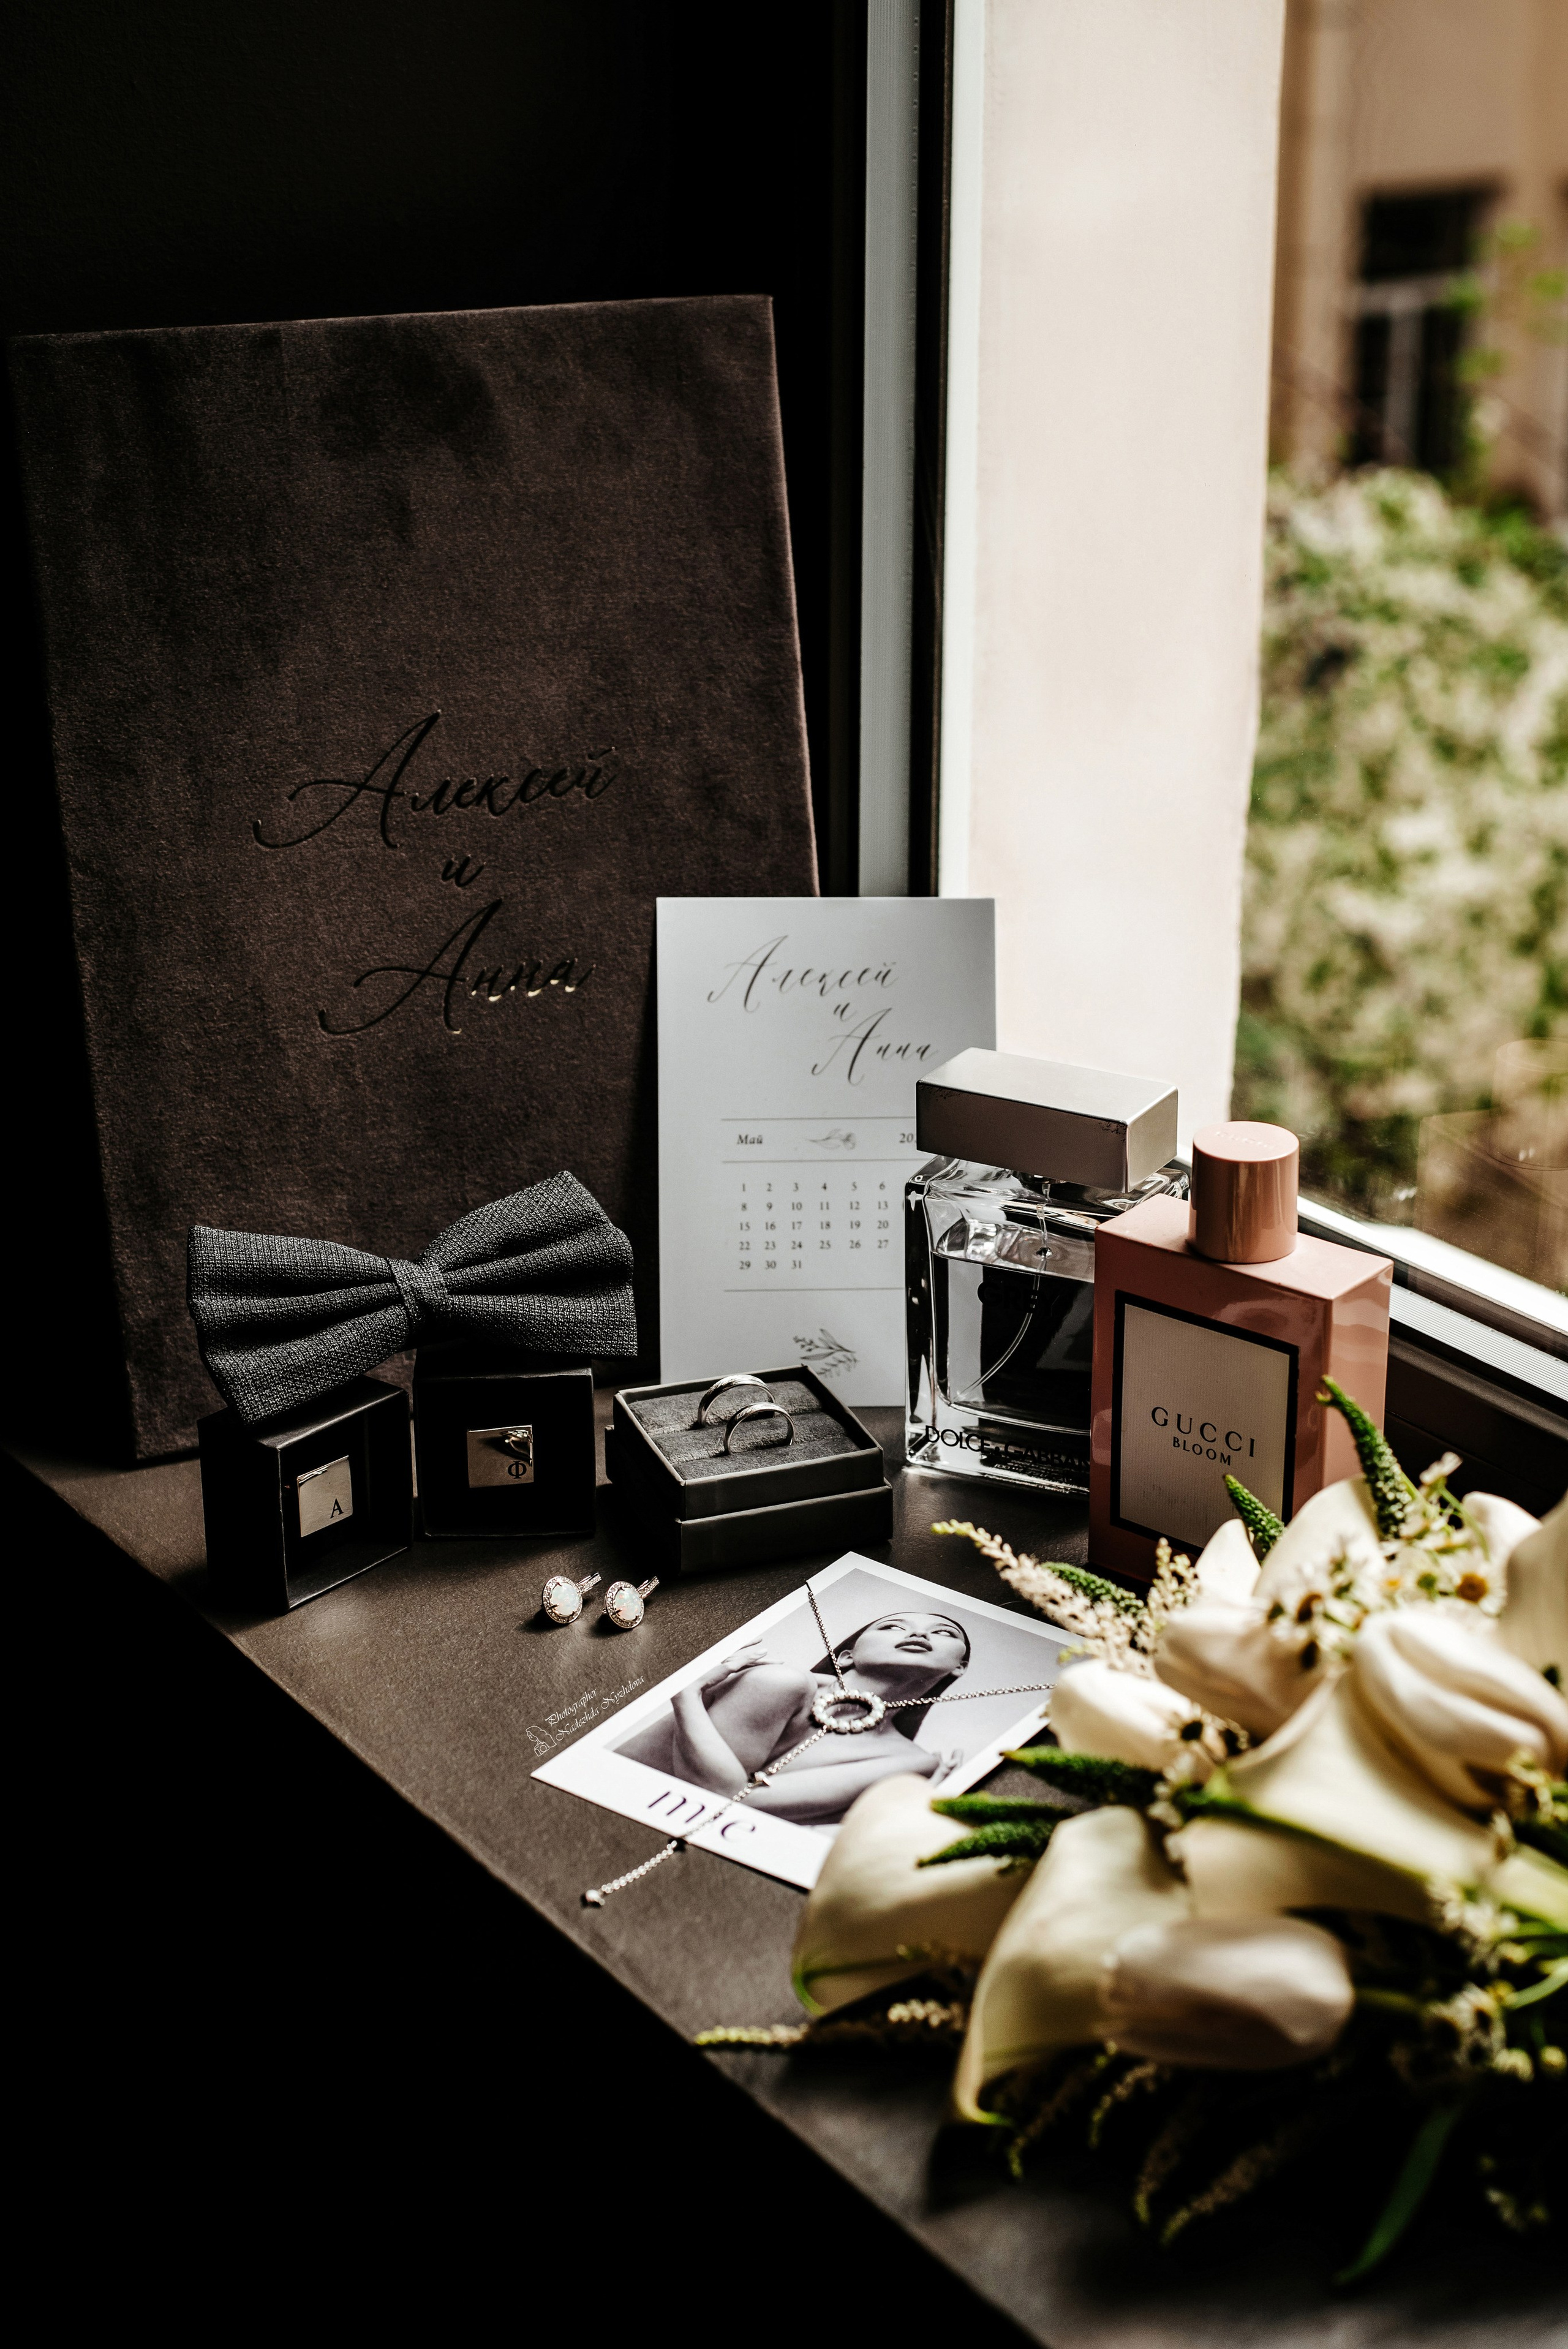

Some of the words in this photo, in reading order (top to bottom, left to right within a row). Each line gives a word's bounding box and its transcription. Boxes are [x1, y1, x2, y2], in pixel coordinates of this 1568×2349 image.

[253, 709, 616, 850] Алексей
[441, 855, 486, 888] и
[317, 898, 596, 1035] Анна
[707, 935, 899, 1013] Алексей
[833, 1002, 858, 1022] и
[811, 1008, 939, 1085] Анна
[736, 1133, 763, 1145] Май
[899, 1133, 916, 1144] 20
[741, 1183, 747, 1193] 1
[766, 1183, 772, 1192] 2
[793, 1182, 799, 1192] 3
[821, 1182, 827, 1191] 4
[851, 1181, 858, 1191] 5
[878, 1182, 886, 1191] 6
[741, 1202, 747, 1212] 8
[766, 1202, 773, 1211] 9
[791, 1202, 803, 1211] 10
[820, 1201, 830, 1210] 11
[849, 1201, 861, 1210] 12
[877, 1201, 889, 1210] 13
[739, 1221, 751, 1231] 15
[764, 1221, 777, 1231] 16
[791, 1221, 803, 1231] 17
[820, 1221, 831, 1230] 18
[849, 1220, 861, 1229] 19
[877, 1220, 889, 1229] 20
[739, 1241, 751, 1251] 22
[764, 1240, 776, 1250] 23
[791, 1240, 803, 1250] 24
[820, 1240, 831, 1250] 25
[849, 1240, 861, 1250] 26
[877, 1239, 889, 1249] 27
[739, 1261, 752, 1270] 29
[765, 1260, 777, 1270] 30
[791, 1260, 802, 1270] 31
[1151, 1406, 1256, 1458] GUCCI
[1172, 1436, 1231, 1466] BLOOM
